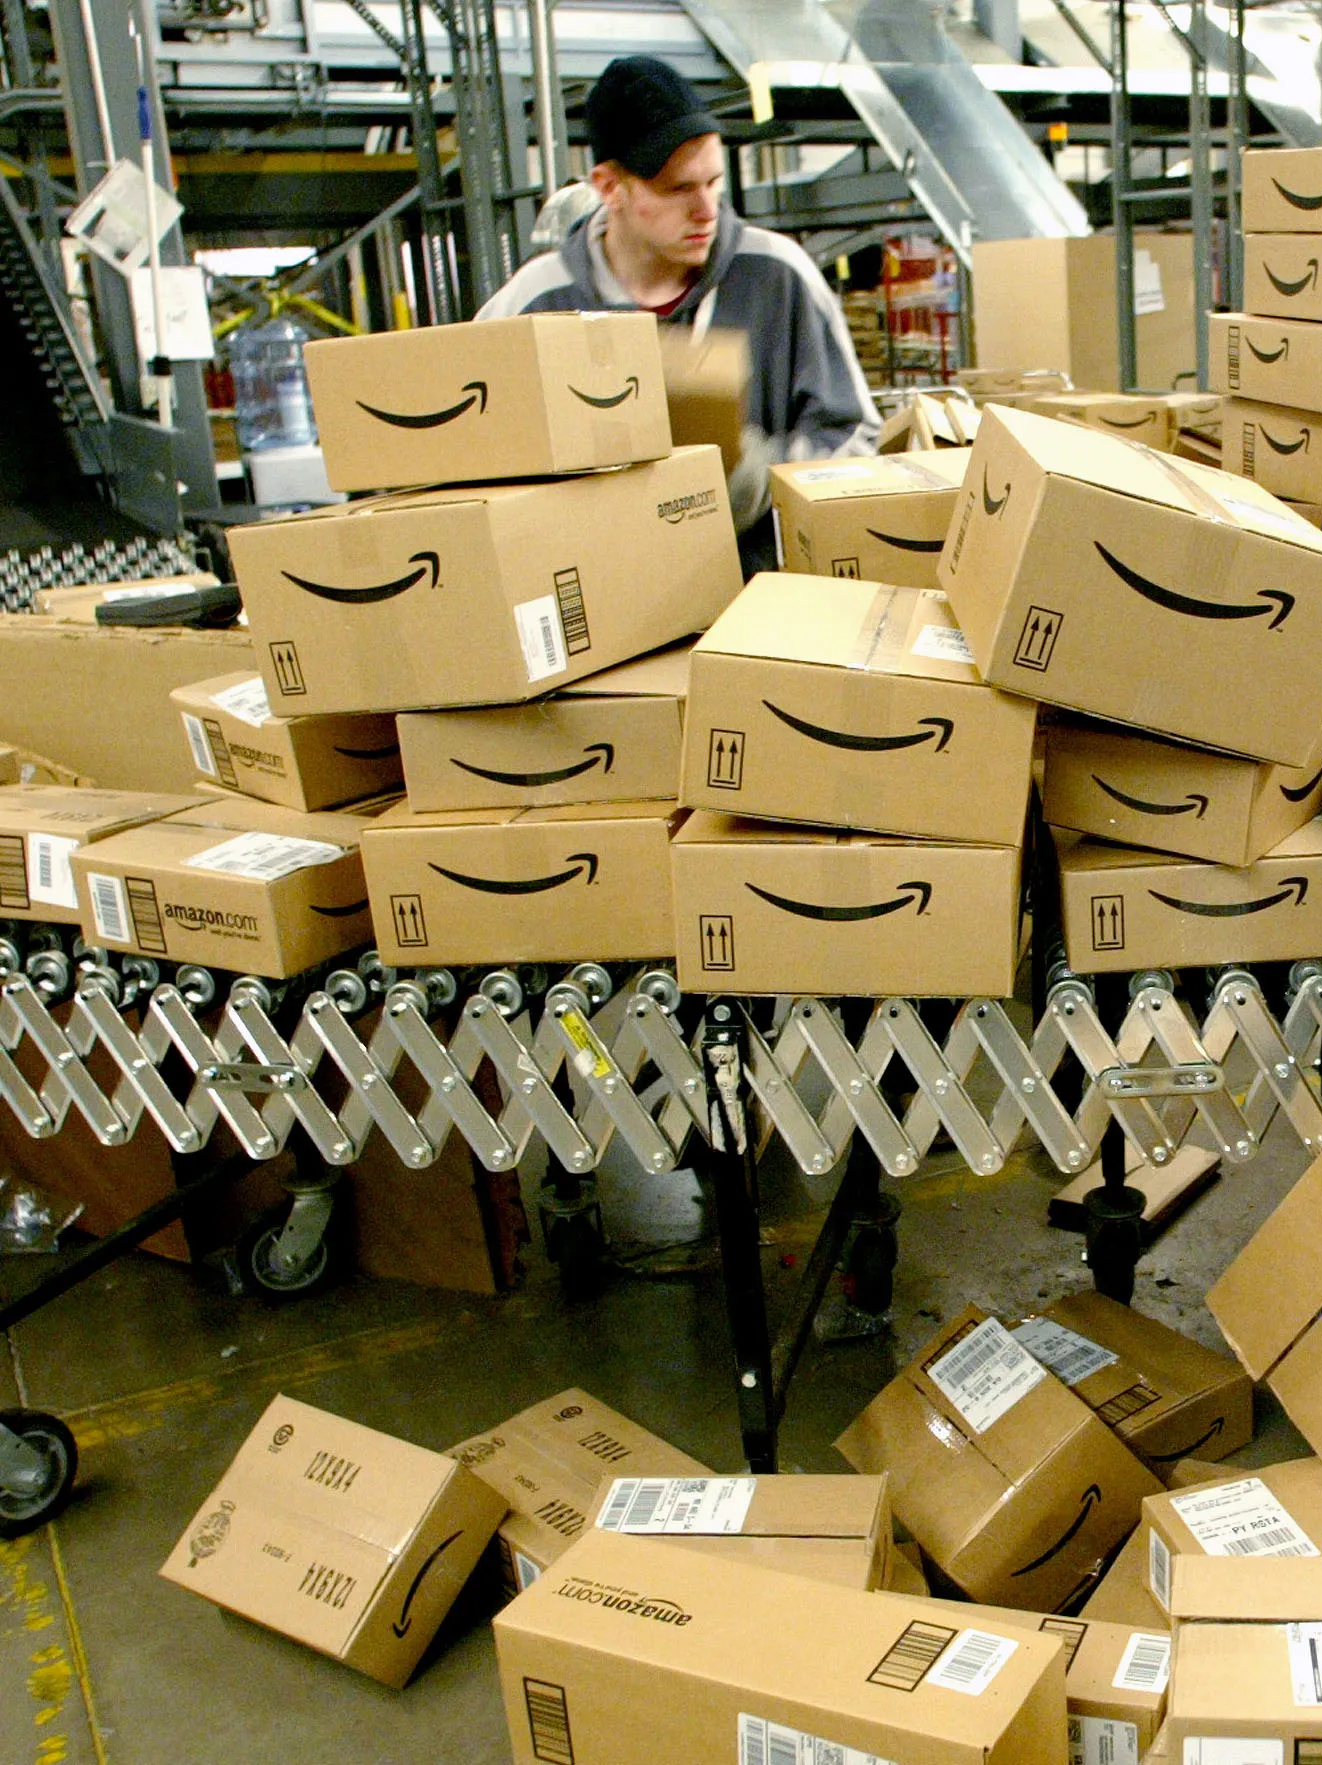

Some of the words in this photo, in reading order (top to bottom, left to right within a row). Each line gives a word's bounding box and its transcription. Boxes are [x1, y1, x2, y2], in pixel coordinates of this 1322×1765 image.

[163, 903, 258, 931] amazon.com
[304, 1450, 361, 1493] 12X9X4
[297, 1561, 358, 1610] 12X9X4
[556, 1583, 693, 1627] amazon.com
